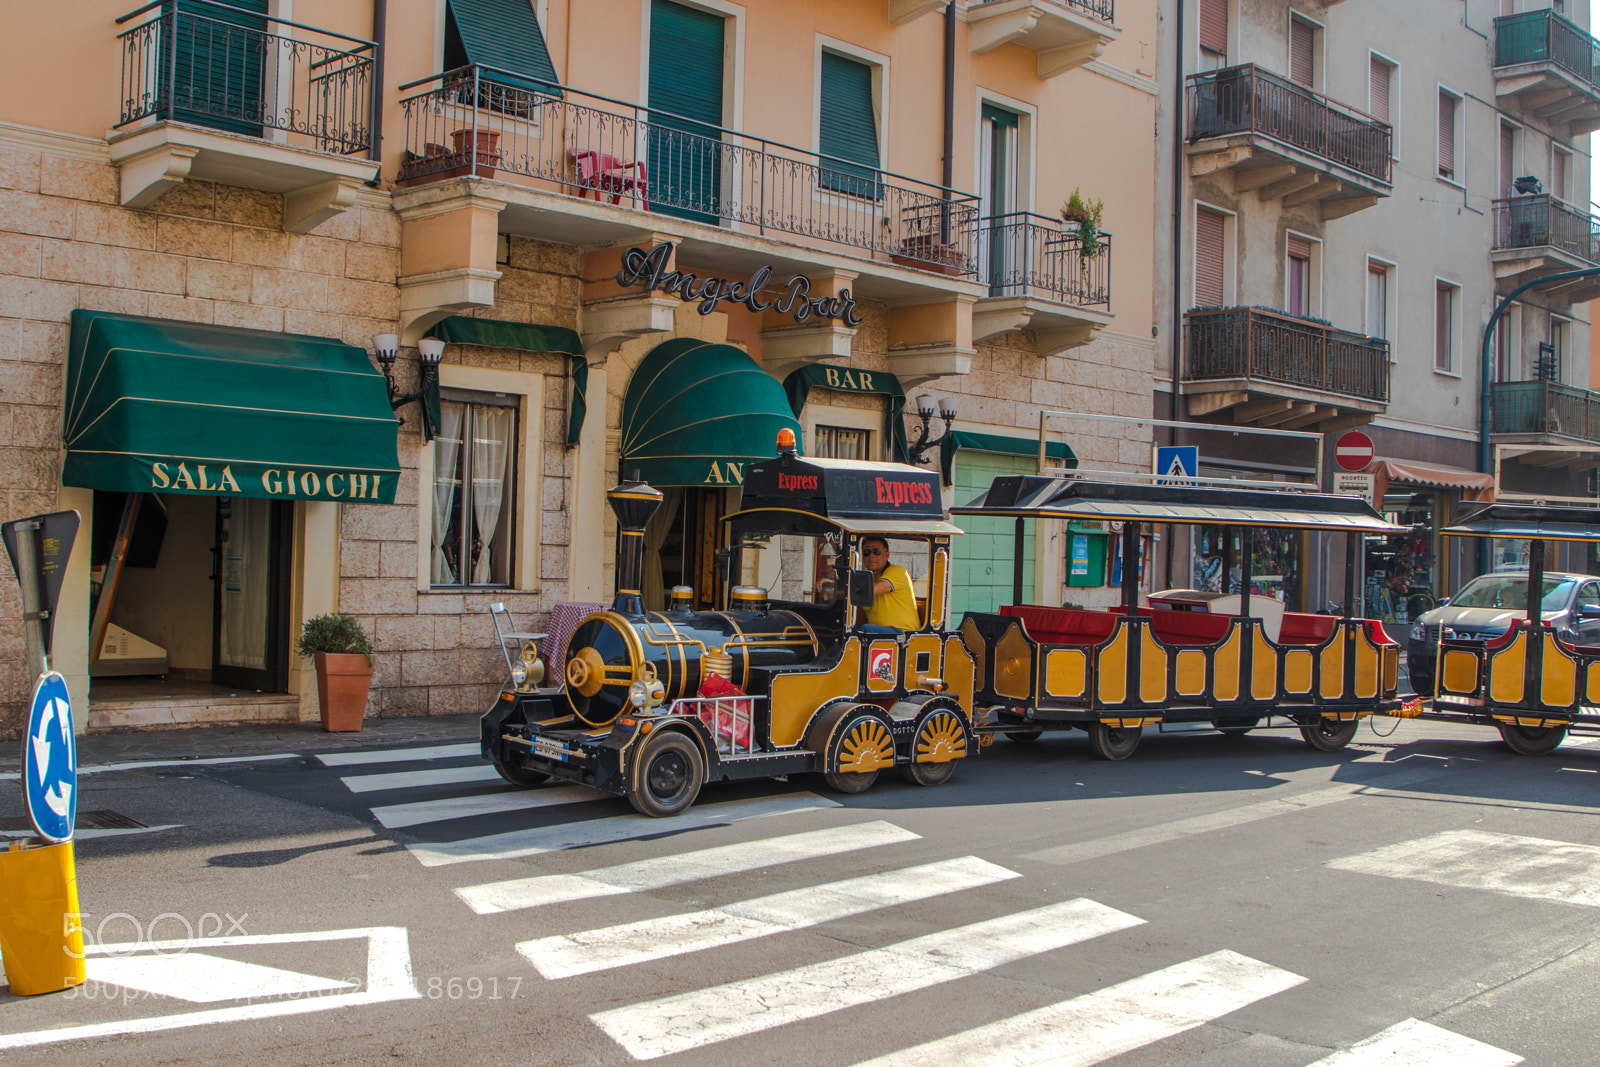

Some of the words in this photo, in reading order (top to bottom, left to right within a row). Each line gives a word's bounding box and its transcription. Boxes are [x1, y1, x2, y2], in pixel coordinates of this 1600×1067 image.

[616, 241, 774, 315] Angel
[774, 274, 862, 327] Bar
[825, 368, 875, 391] BAR
[151, 461, 242, 492] SALA
[261, 469, 381, 499] GIOCHI
[703, 460, 747, 485] AN
[778, 472, 818, 492] Express
[893, 726, 915, 734] DOTTO
